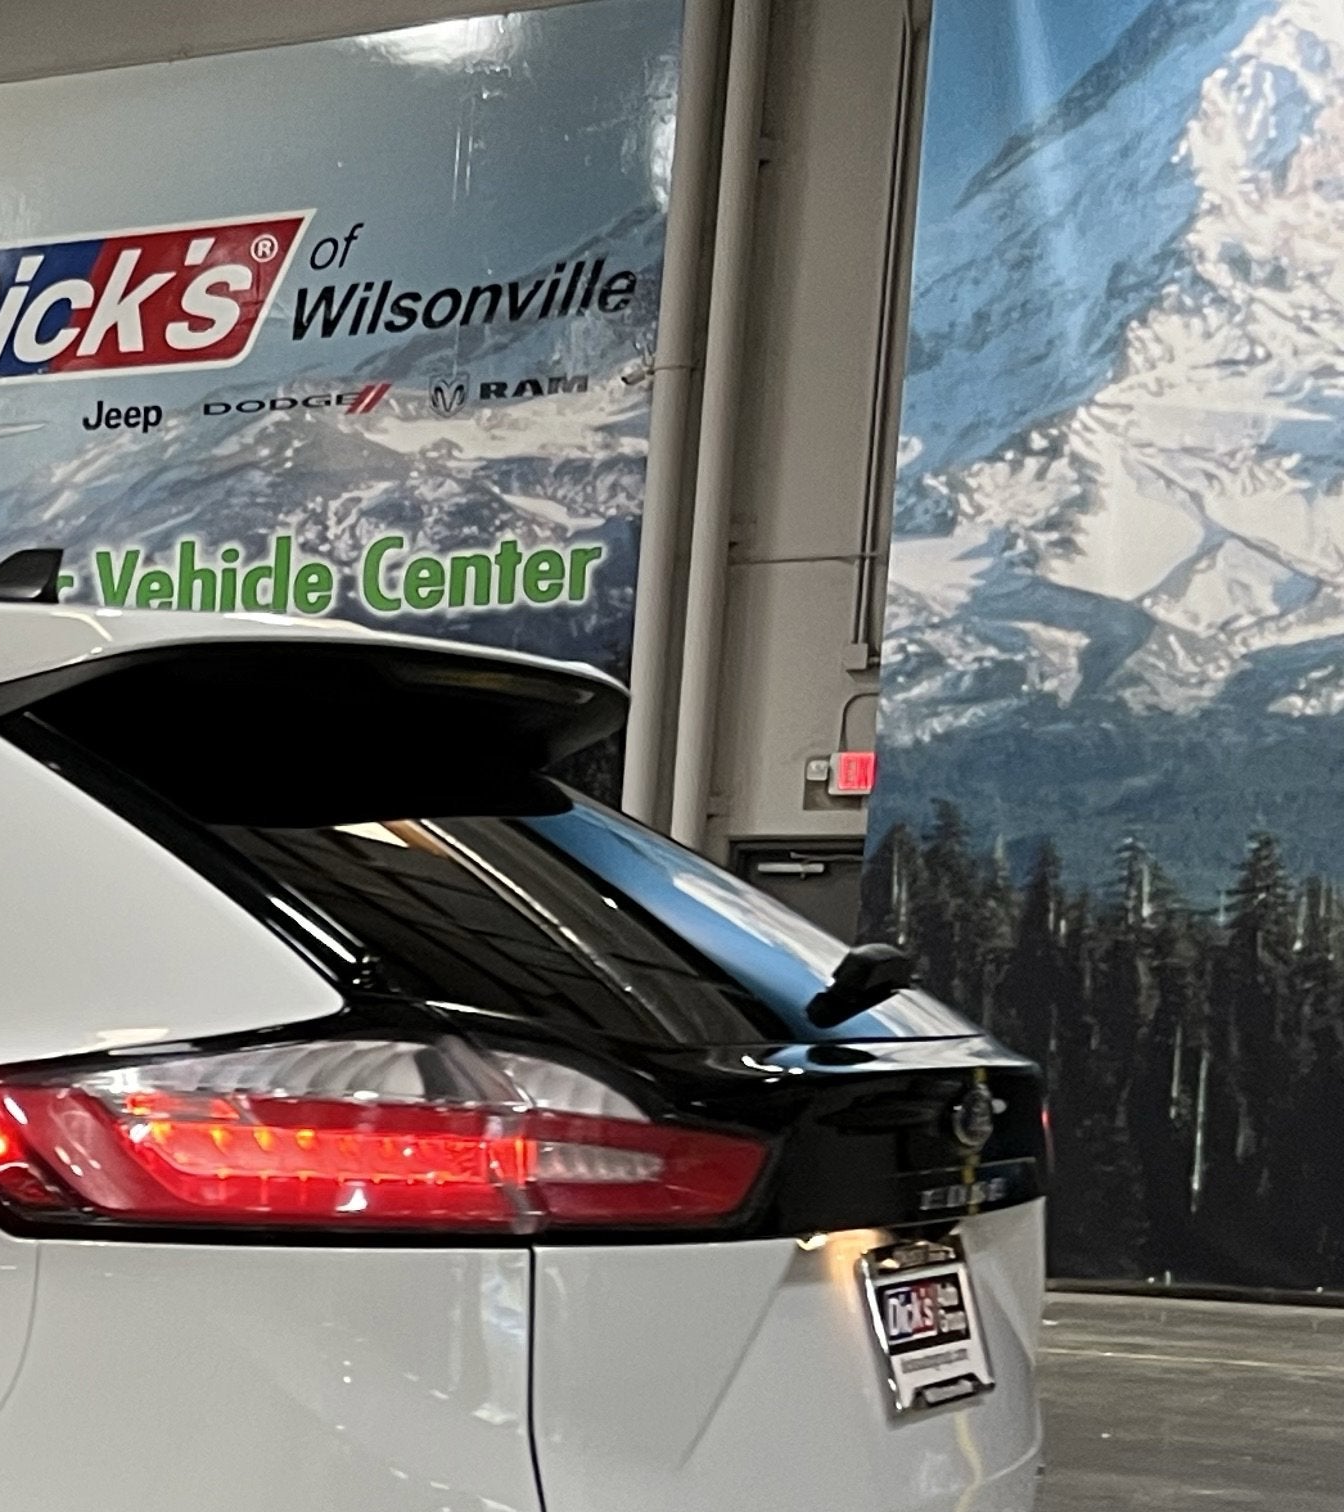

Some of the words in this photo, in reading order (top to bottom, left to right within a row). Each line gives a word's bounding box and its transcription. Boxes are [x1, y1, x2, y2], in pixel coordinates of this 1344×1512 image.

[310, 223, 364, 270] of
[292, 255, 637, 341] Wilsonville
[203, 391, 360, 416] DODGE
[479, 373, 589, 400] RAM
[82, 400, 162, 434] Jeep
[96, 536, 334, 614] Vehicle
[363, 536, 603, 612] Center
